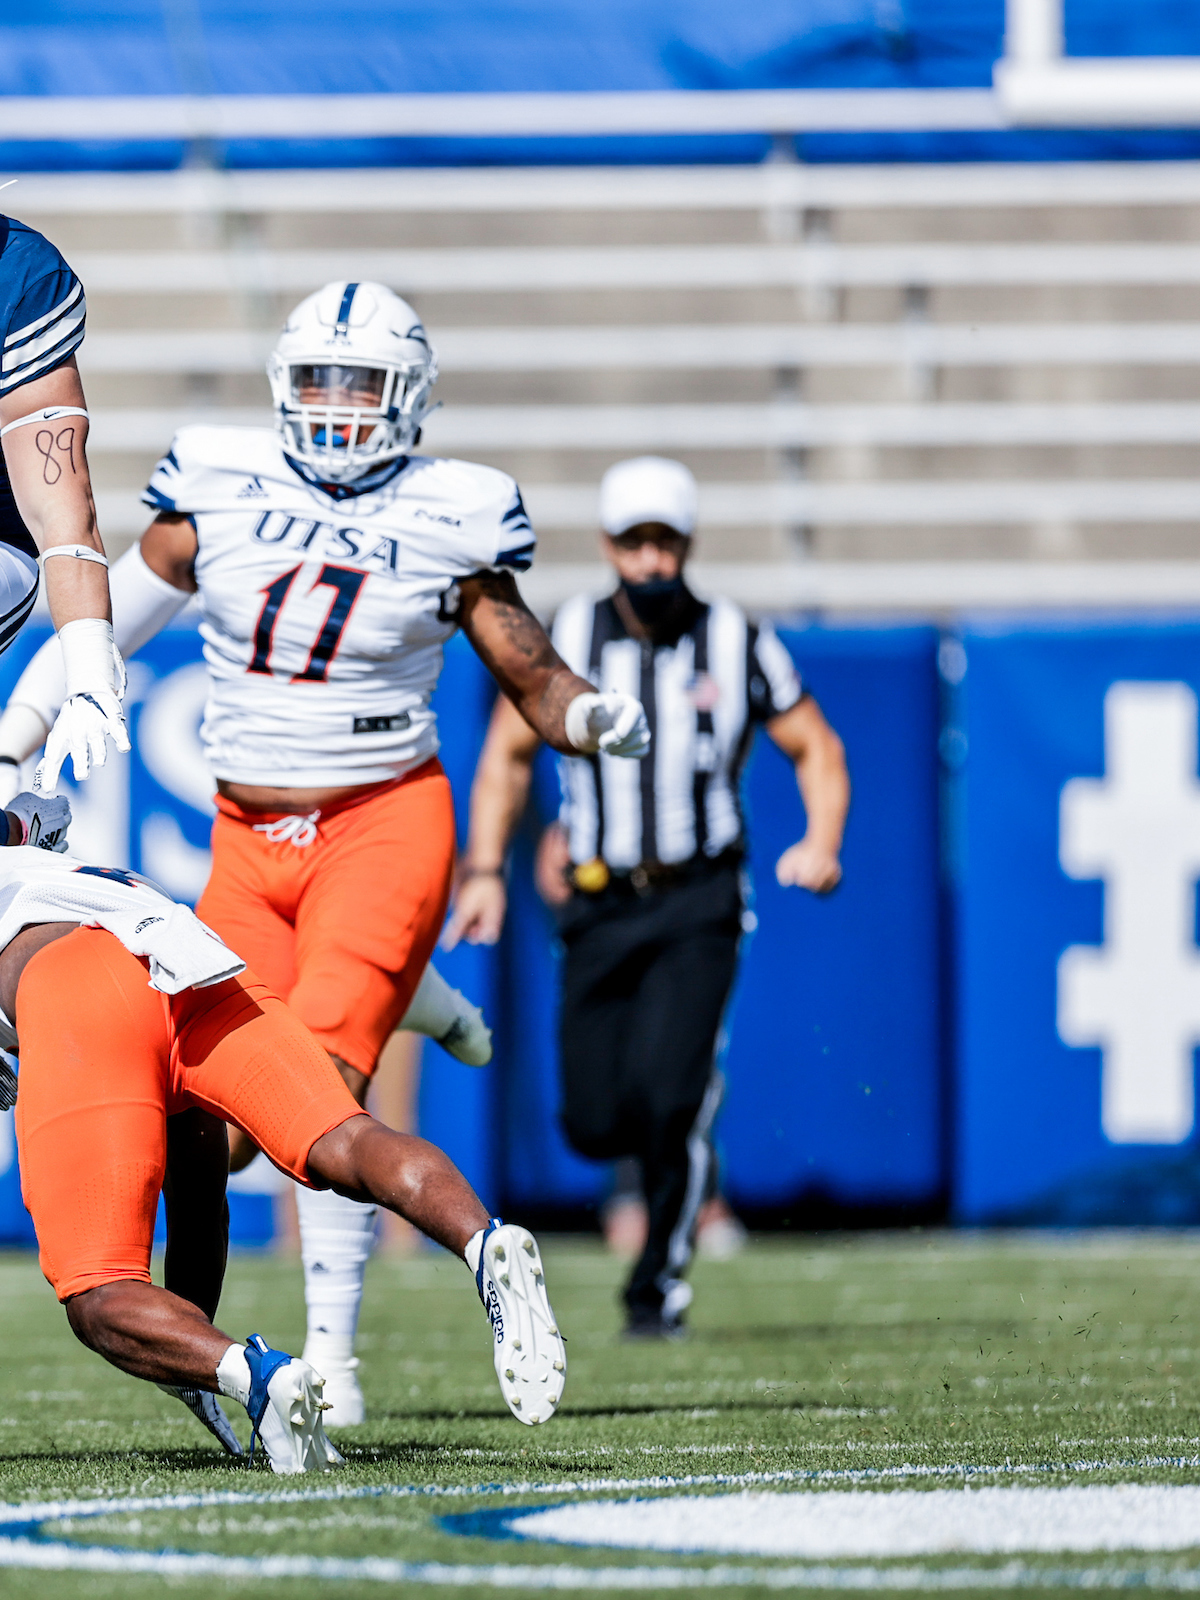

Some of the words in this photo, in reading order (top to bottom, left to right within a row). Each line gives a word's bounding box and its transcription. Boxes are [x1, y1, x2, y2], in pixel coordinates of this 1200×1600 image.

[35, 427, 77, 485] 89
[251, 510, 398, 574] UTSA
[246, 561, 370, 685] 17
[487, 1280, 504, 1344] adidas
